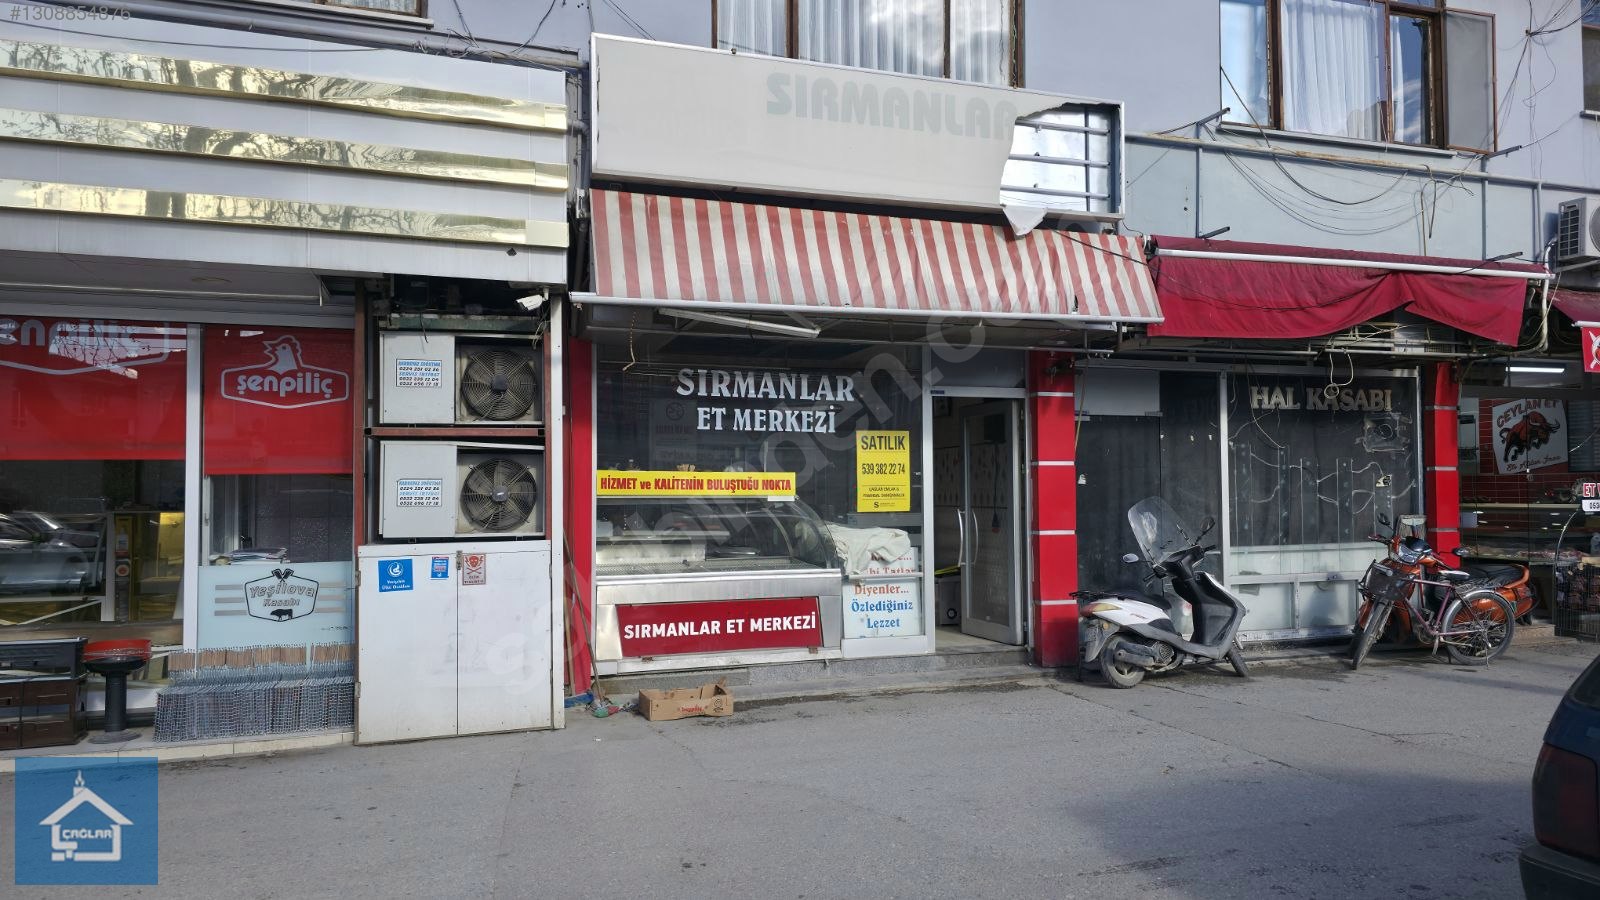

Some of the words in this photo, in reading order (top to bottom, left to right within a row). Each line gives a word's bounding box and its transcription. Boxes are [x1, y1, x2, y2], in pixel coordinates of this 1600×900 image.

[237, 372, 333, 399] şenpiliç
[676, 368, 855, 401] SIRMANLAR
[1251, 386, 1300, 410] HAL
[1306, 387, 1393, 412] KASABI
[697, 407, 726, 431] ET
[733, 404, 836, 433] MERKEZİ
[861, 435, 906, 450] SATILIK
[862, 463, 874, 475] 539
[876, 463, 888, 475] 382
[888, 463, 897, 475] 22
[898, 463, 906, 475] 74
[600, 475, 638, 490] HİZMET
[640, 480, 652, 490] ve
[654, 475, 704, 491] KALİTENİN
[706, 476, 760, 493] BULUŞTUĞU
[761, 479, 792, 491] NOKTA
[1583, 482, 1596, 498] ET
[249, 583, 316, 598] Yeşilova
[854, 584, 909, 597] Diyenler...
[851, 598, 914, 613] Özlediğiniz
[624, 620, 721, 639] SIRMANLAR
[726, 618, 745, 634] ET
[750, 611, 817, 632] MERKEZİ
[866, 618, 900, 629] Lezzet
